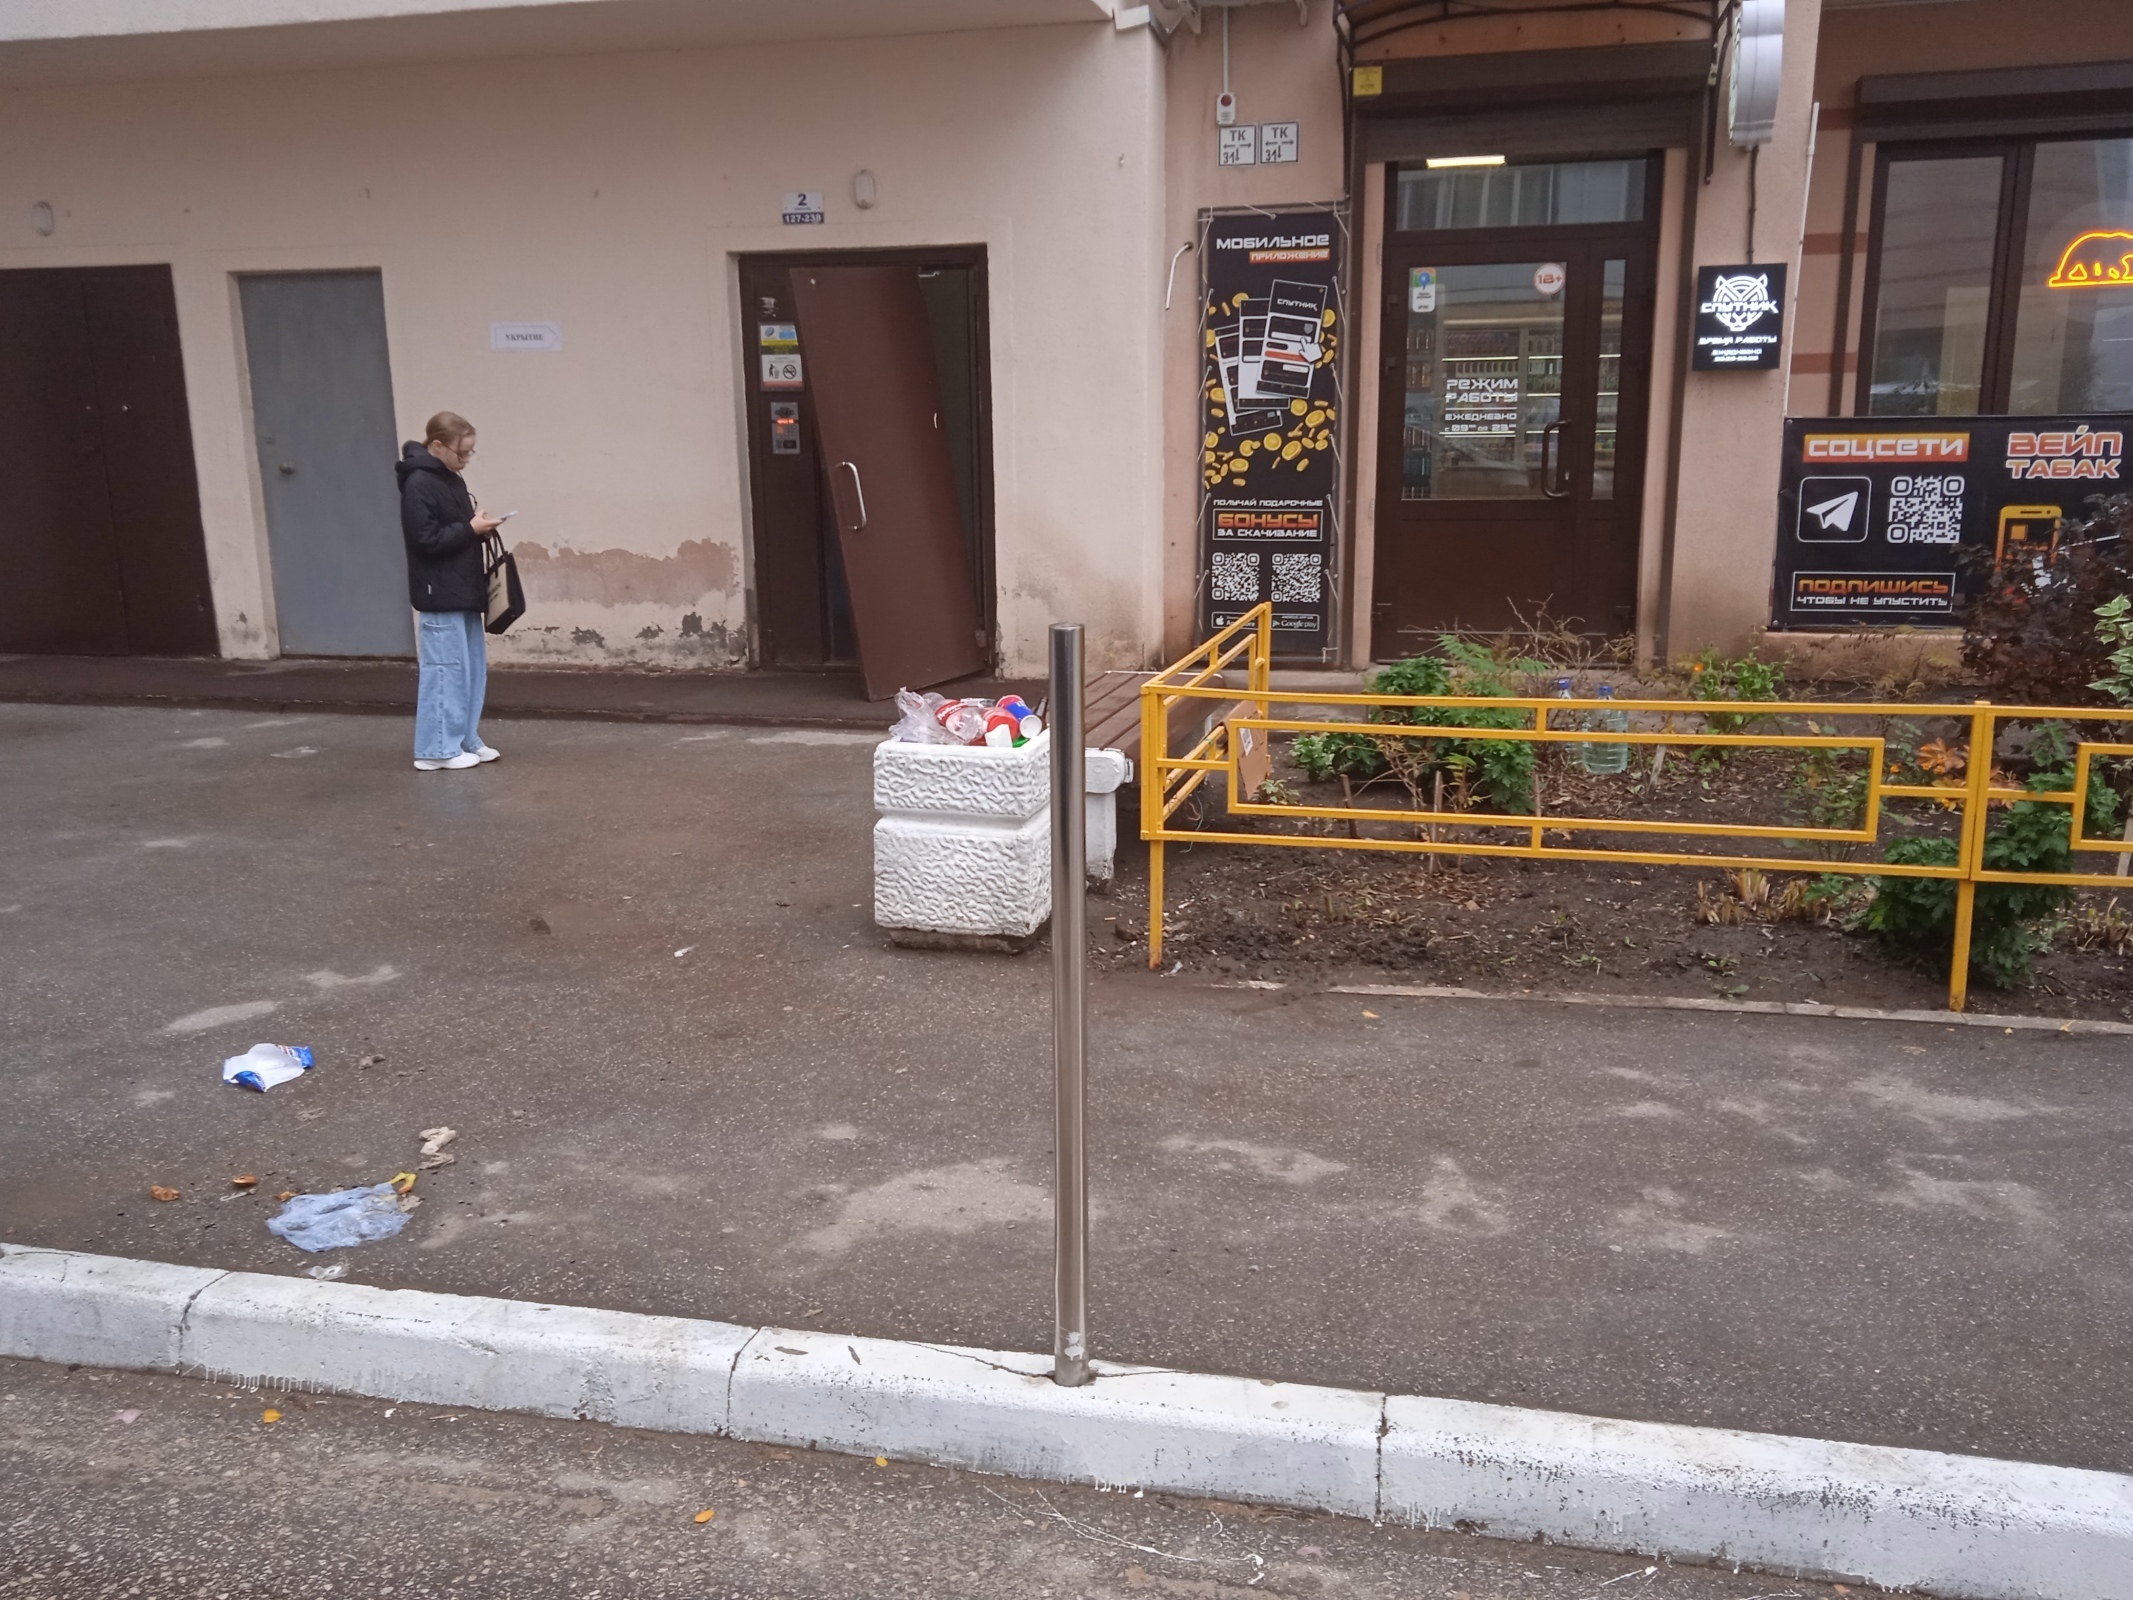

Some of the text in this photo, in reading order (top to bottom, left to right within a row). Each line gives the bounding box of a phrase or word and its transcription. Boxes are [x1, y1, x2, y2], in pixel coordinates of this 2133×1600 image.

[1229, 129, 1246, 142] ТК
[1272, 126, 1289, 140] ТК
[797, 192, 808, 207] 2
[1216, 233, 1330, 250] МОБИЛЬНОЕ
[1251, 250, 1329, 261] ПРИЛОЖЕНИЕ
[1537, 273, 1563, 285] 18+
[1277, 298, 1318, 311] СПУТНИК
[1700, 300, 1779, 314] СПУТНИК
[505, 333, 544, 341] УКРЫТИЕ
[1734, 335, 1778, 345] РАБОТЫ
[1446, 378, 1519, 392] РЕЖИМ
[1445, 391, 1518, 403] РАБОТЫ
[1444, 412, 1517, 421] ЕЖЕДНЕВНО
[2007, 425, 2124, 457] ВЕЙП
[1808, 437, 1965, 460] СОЦСЕТИ
[2006, 457, 2121, 479] ТАБАК
[1213, 497, 1323, 508] ПОЛУЧАЙ ПОДАРОЧНЫЕ
[1217, 513, 1318, 528] БОНУСЫ
[1217, 529, 1318, 538] ЗА СКАЧИВАНИЕ
[1798, 579, 1949, 595] ПОДПИШИСЬ
[1797, 595, 1948, 606] ЧТОБЫ НЕ УПУСТИТЬ
[1281, 620, 1303, 629] Google
